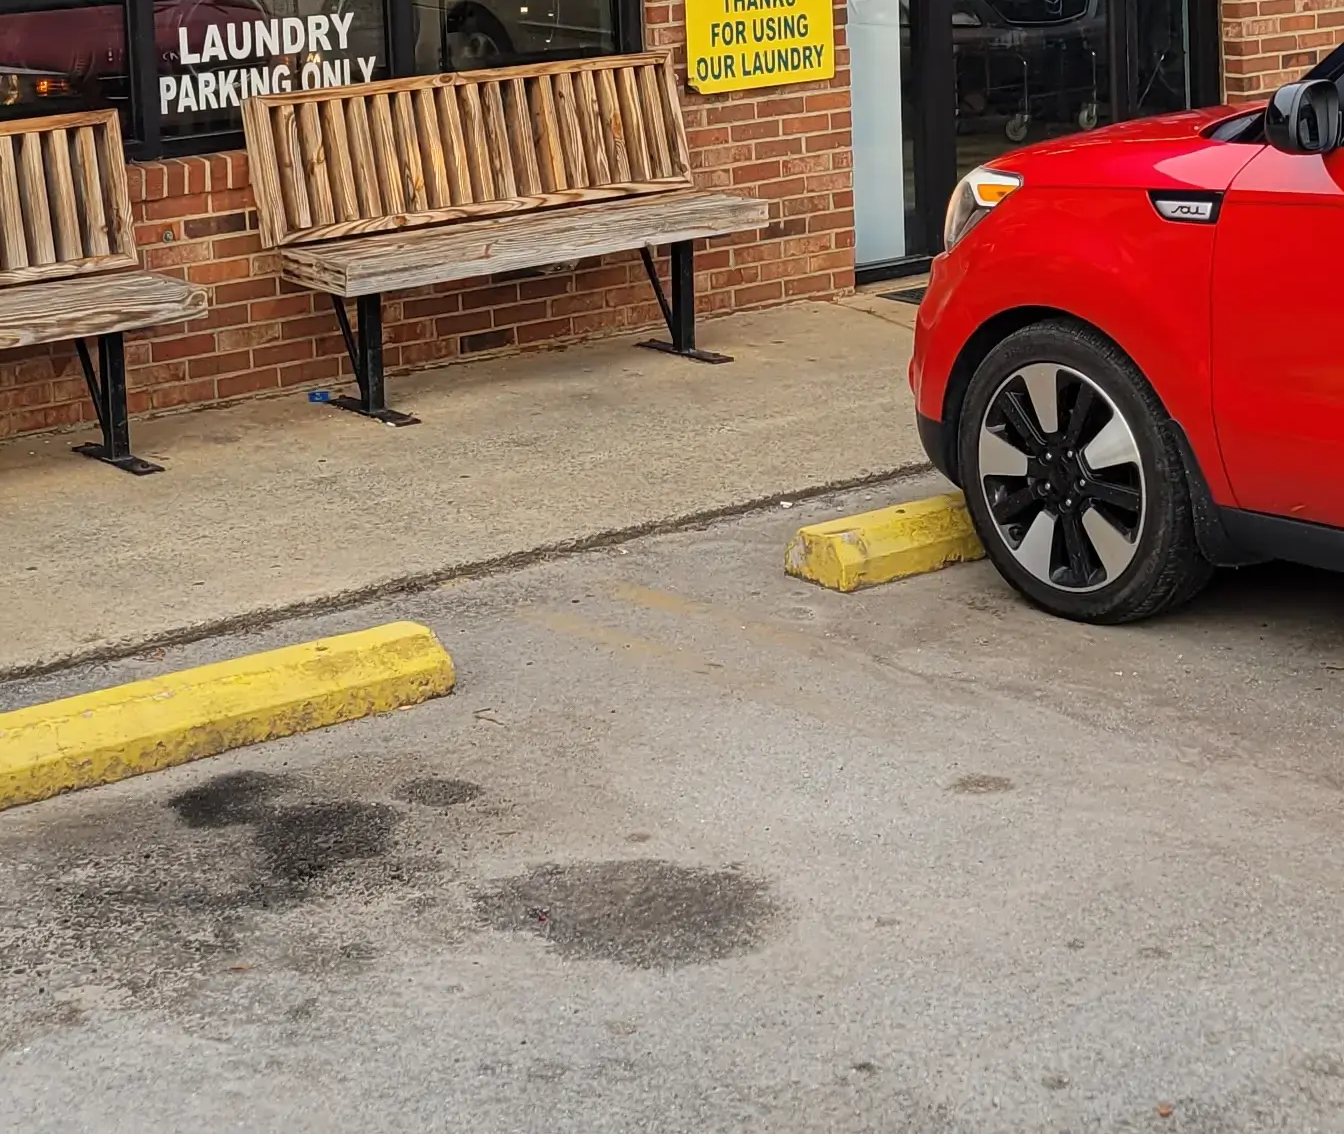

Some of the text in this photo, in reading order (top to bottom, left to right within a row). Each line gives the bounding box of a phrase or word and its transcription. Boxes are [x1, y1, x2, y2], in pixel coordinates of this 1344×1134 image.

[178, 12, 354, 65] LAUNDRY
[710, 14, 808, 47] FOR USING
[696, 44, 824, 81] OUR LAUNDRY
[159, 64, 292, 115] PARKING
